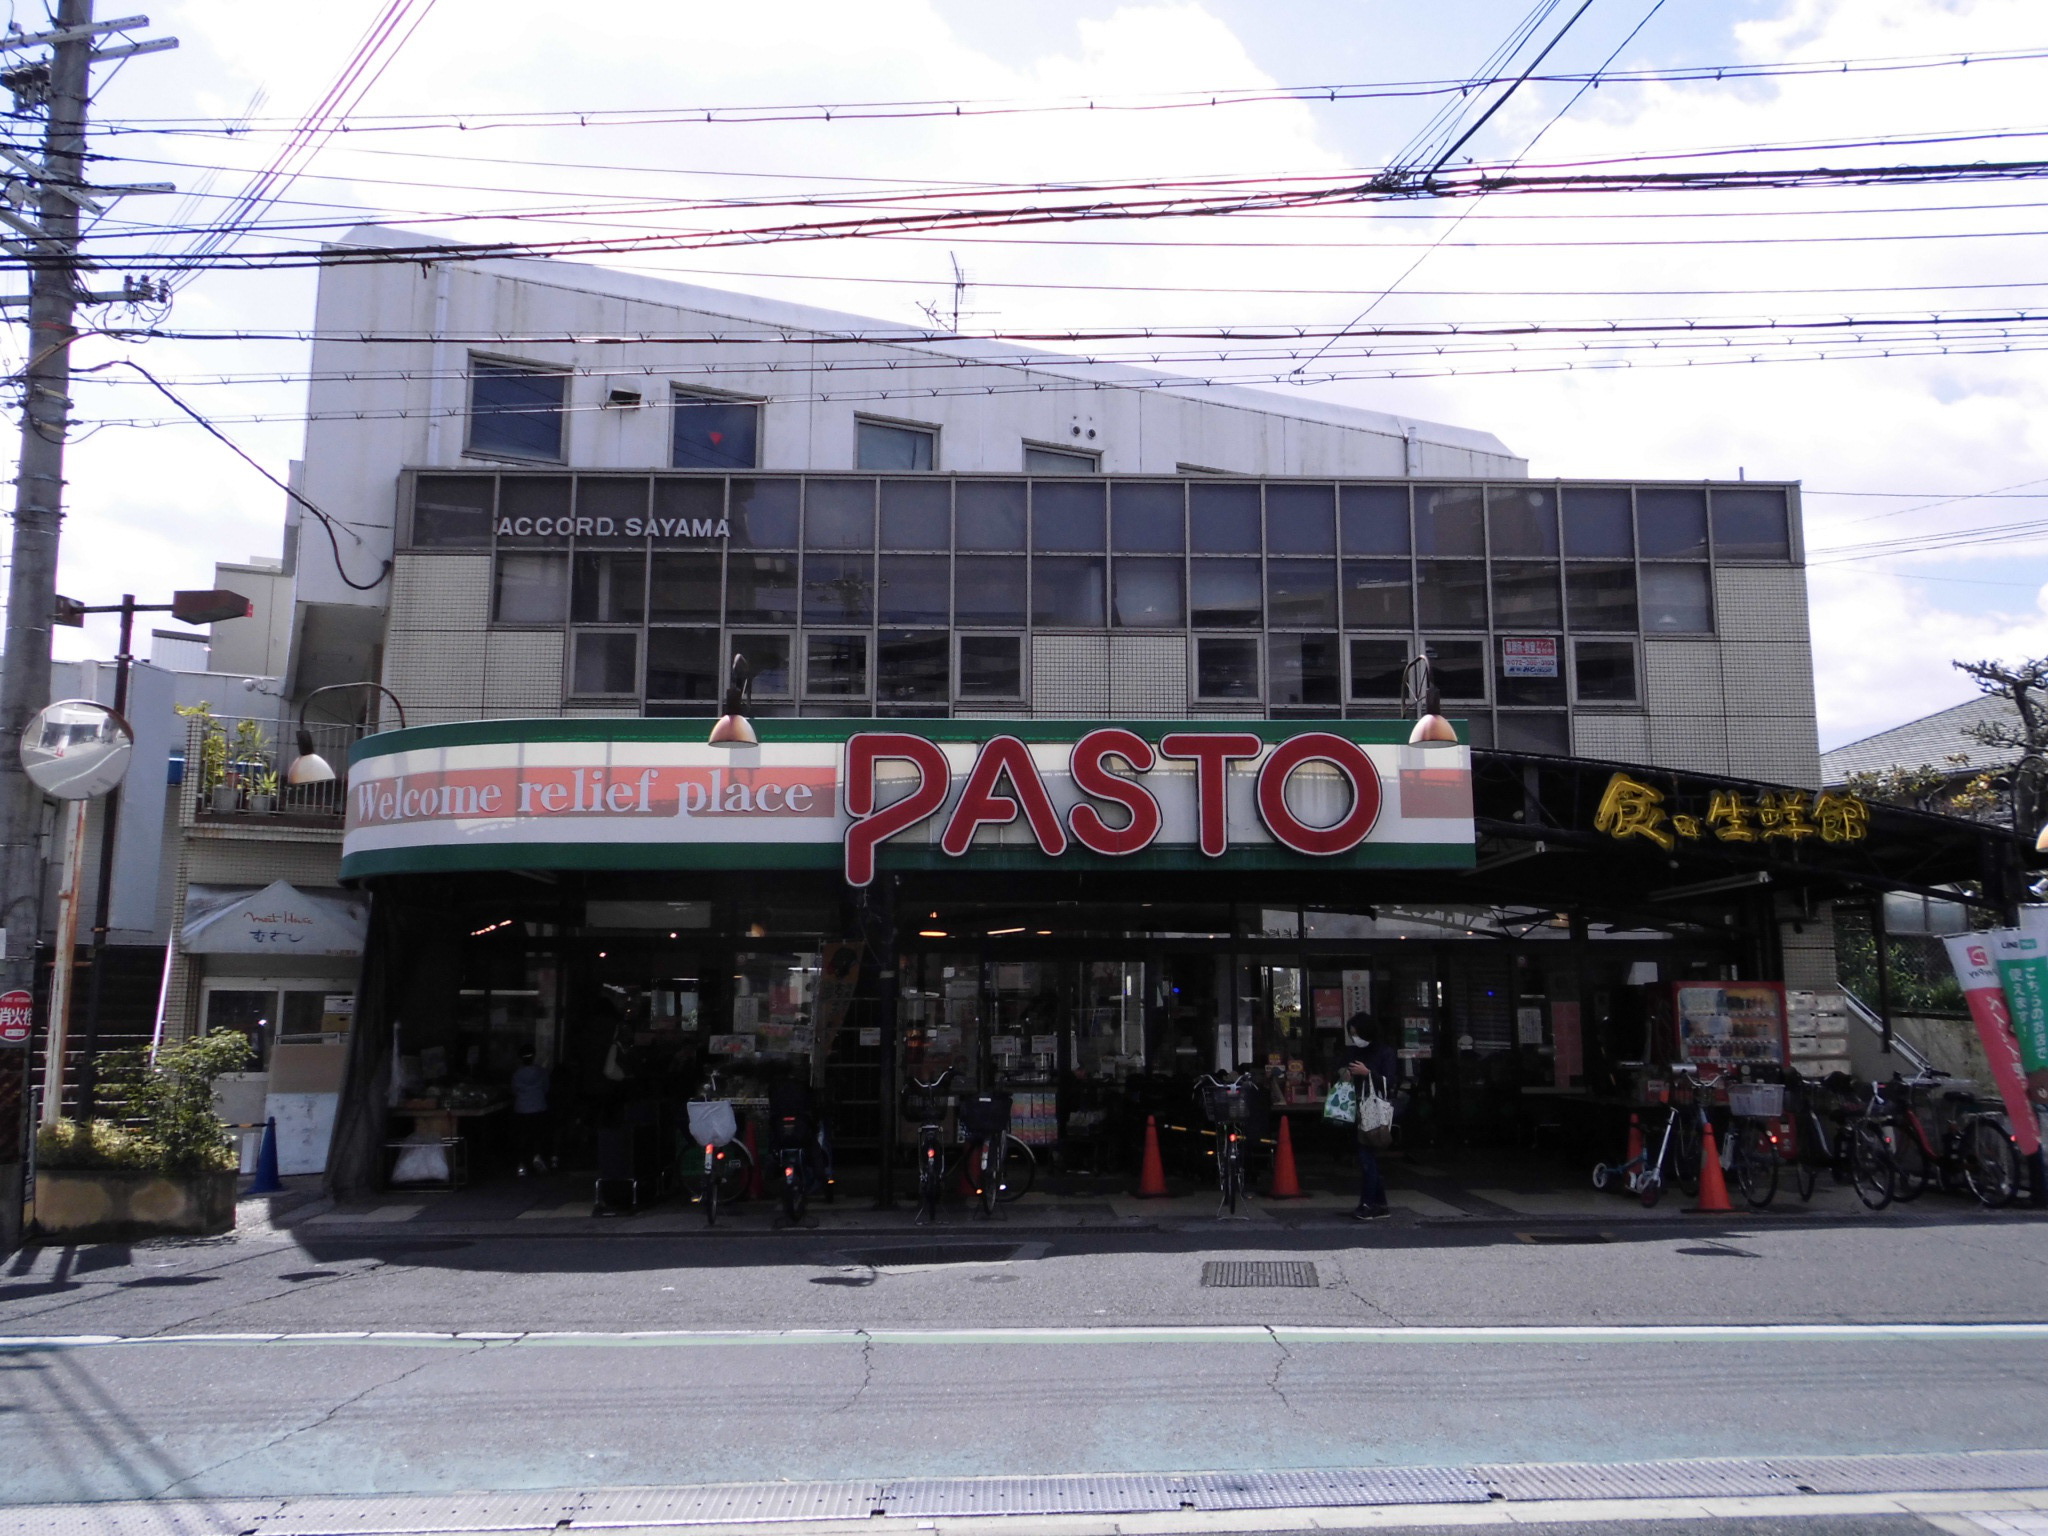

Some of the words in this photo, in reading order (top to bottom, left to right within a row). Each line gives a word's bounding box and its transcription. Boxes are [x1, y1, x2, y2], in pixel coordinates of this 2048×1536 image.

[496, 517, 618, 536] ACCORD.
[625, 518, 730, 538] SAYAMA
[355, 777, 503, 823] Welcome
[518, 768, 659, 812] relief
[676, 768, 814, 818] place
[843, 728, 1383, 887] PASTO
